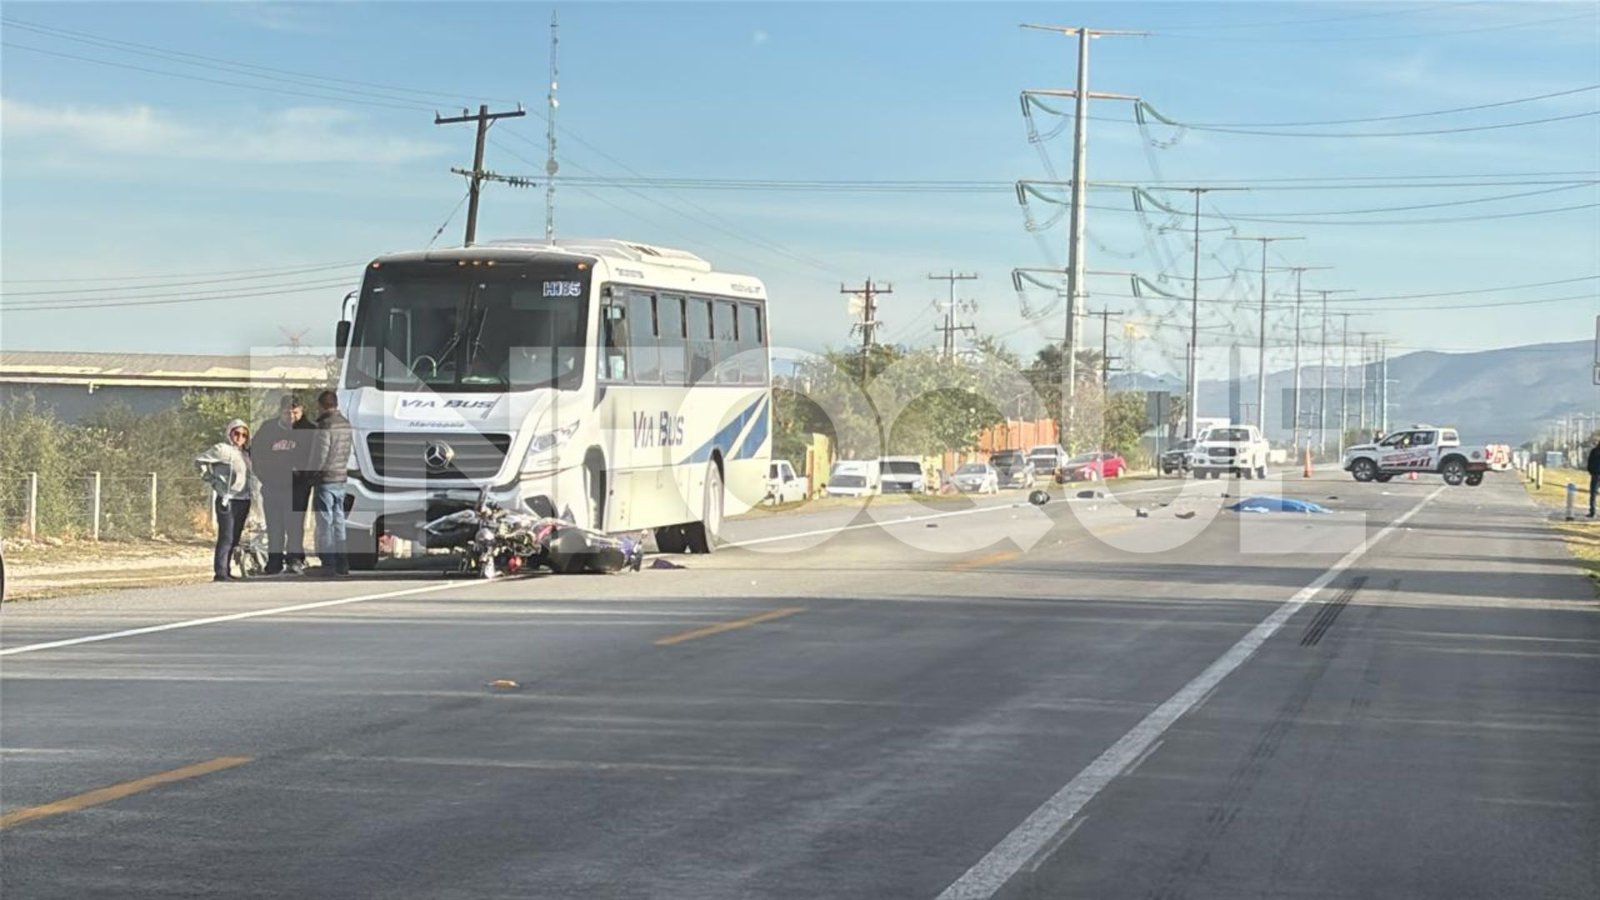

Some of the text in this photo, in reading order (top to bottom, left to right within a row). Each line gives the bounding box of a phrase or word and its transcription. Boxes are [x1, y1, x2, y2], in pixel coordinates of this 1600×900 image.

[401, 399, 496, 409] VIA BUS
[633, 410, 685, 449] VIA BUS
